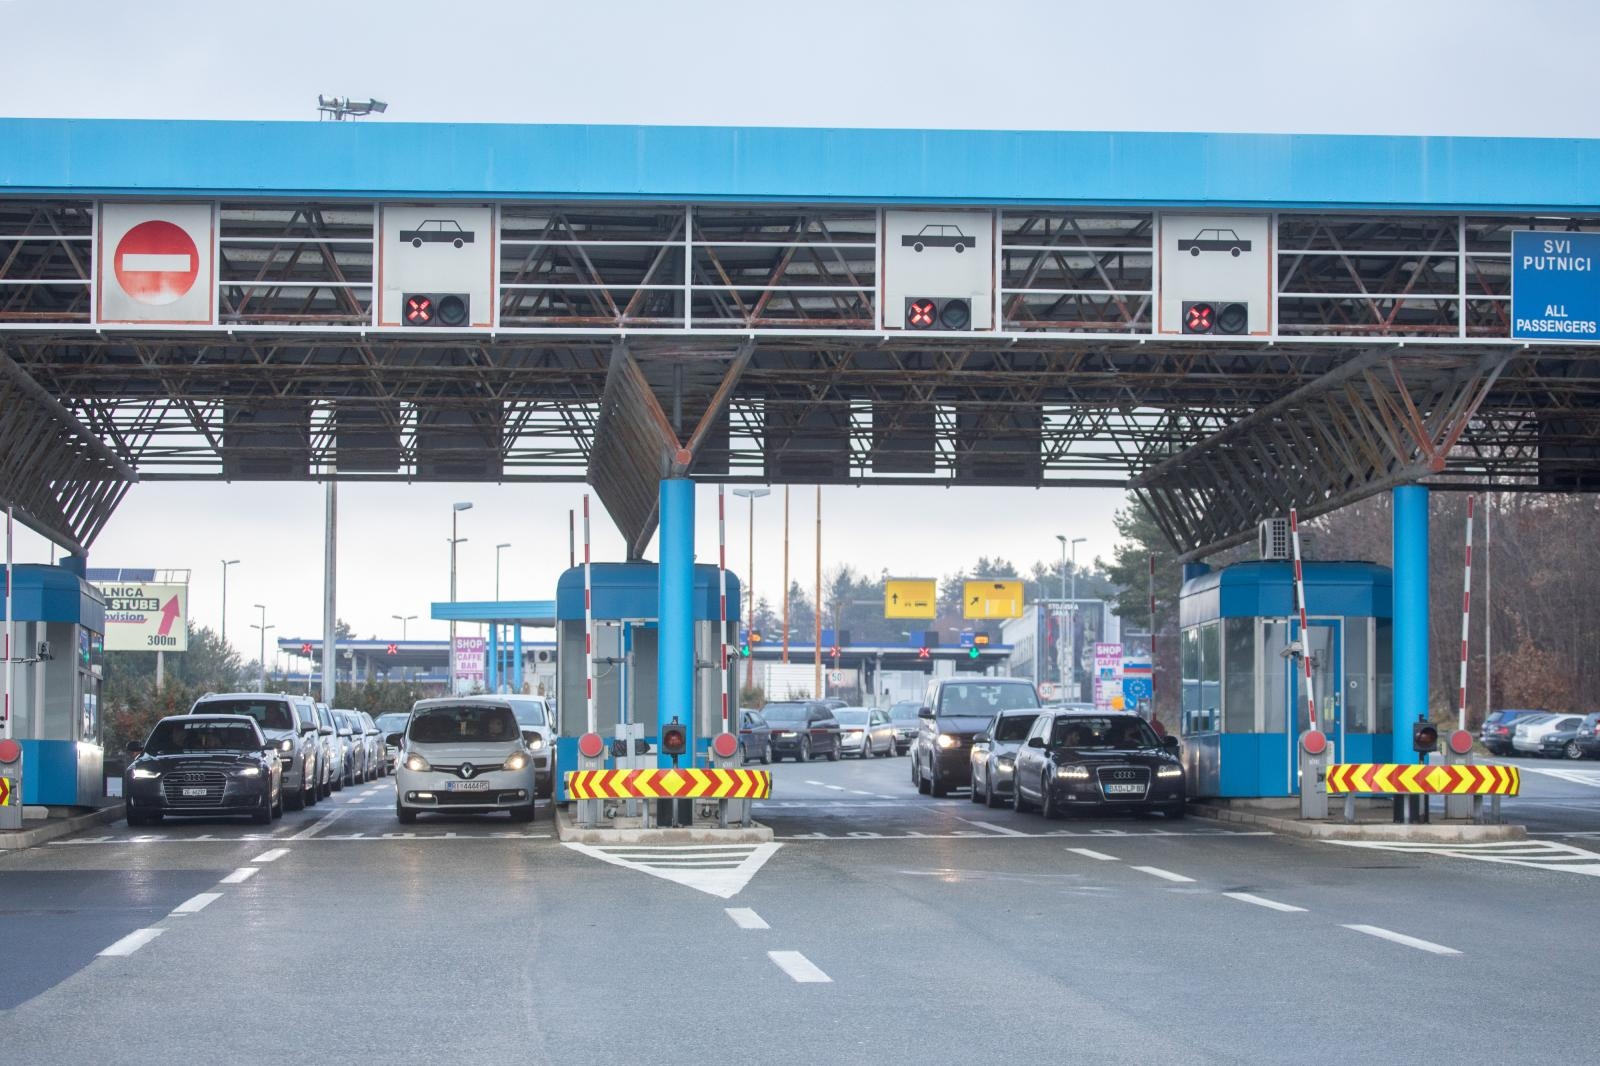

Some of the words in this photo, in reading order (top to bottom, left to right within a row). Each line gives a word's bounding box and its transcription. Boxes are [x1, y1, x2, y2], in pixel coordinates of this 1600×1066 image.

[1543, 239, 1571, 254] SVI
[1523, 256, 1591, 271] PUTNICI
[1544, 304, 1569, 317] ALL
[1516, 319, 1597, 333] PASSENGERS
[111, 599, 158, 610] STUBE
[147, 635, 177, 646] 300m
[457, 639, 483, 649] SHOP
[1096, 645, 1122, 655] SHOP
